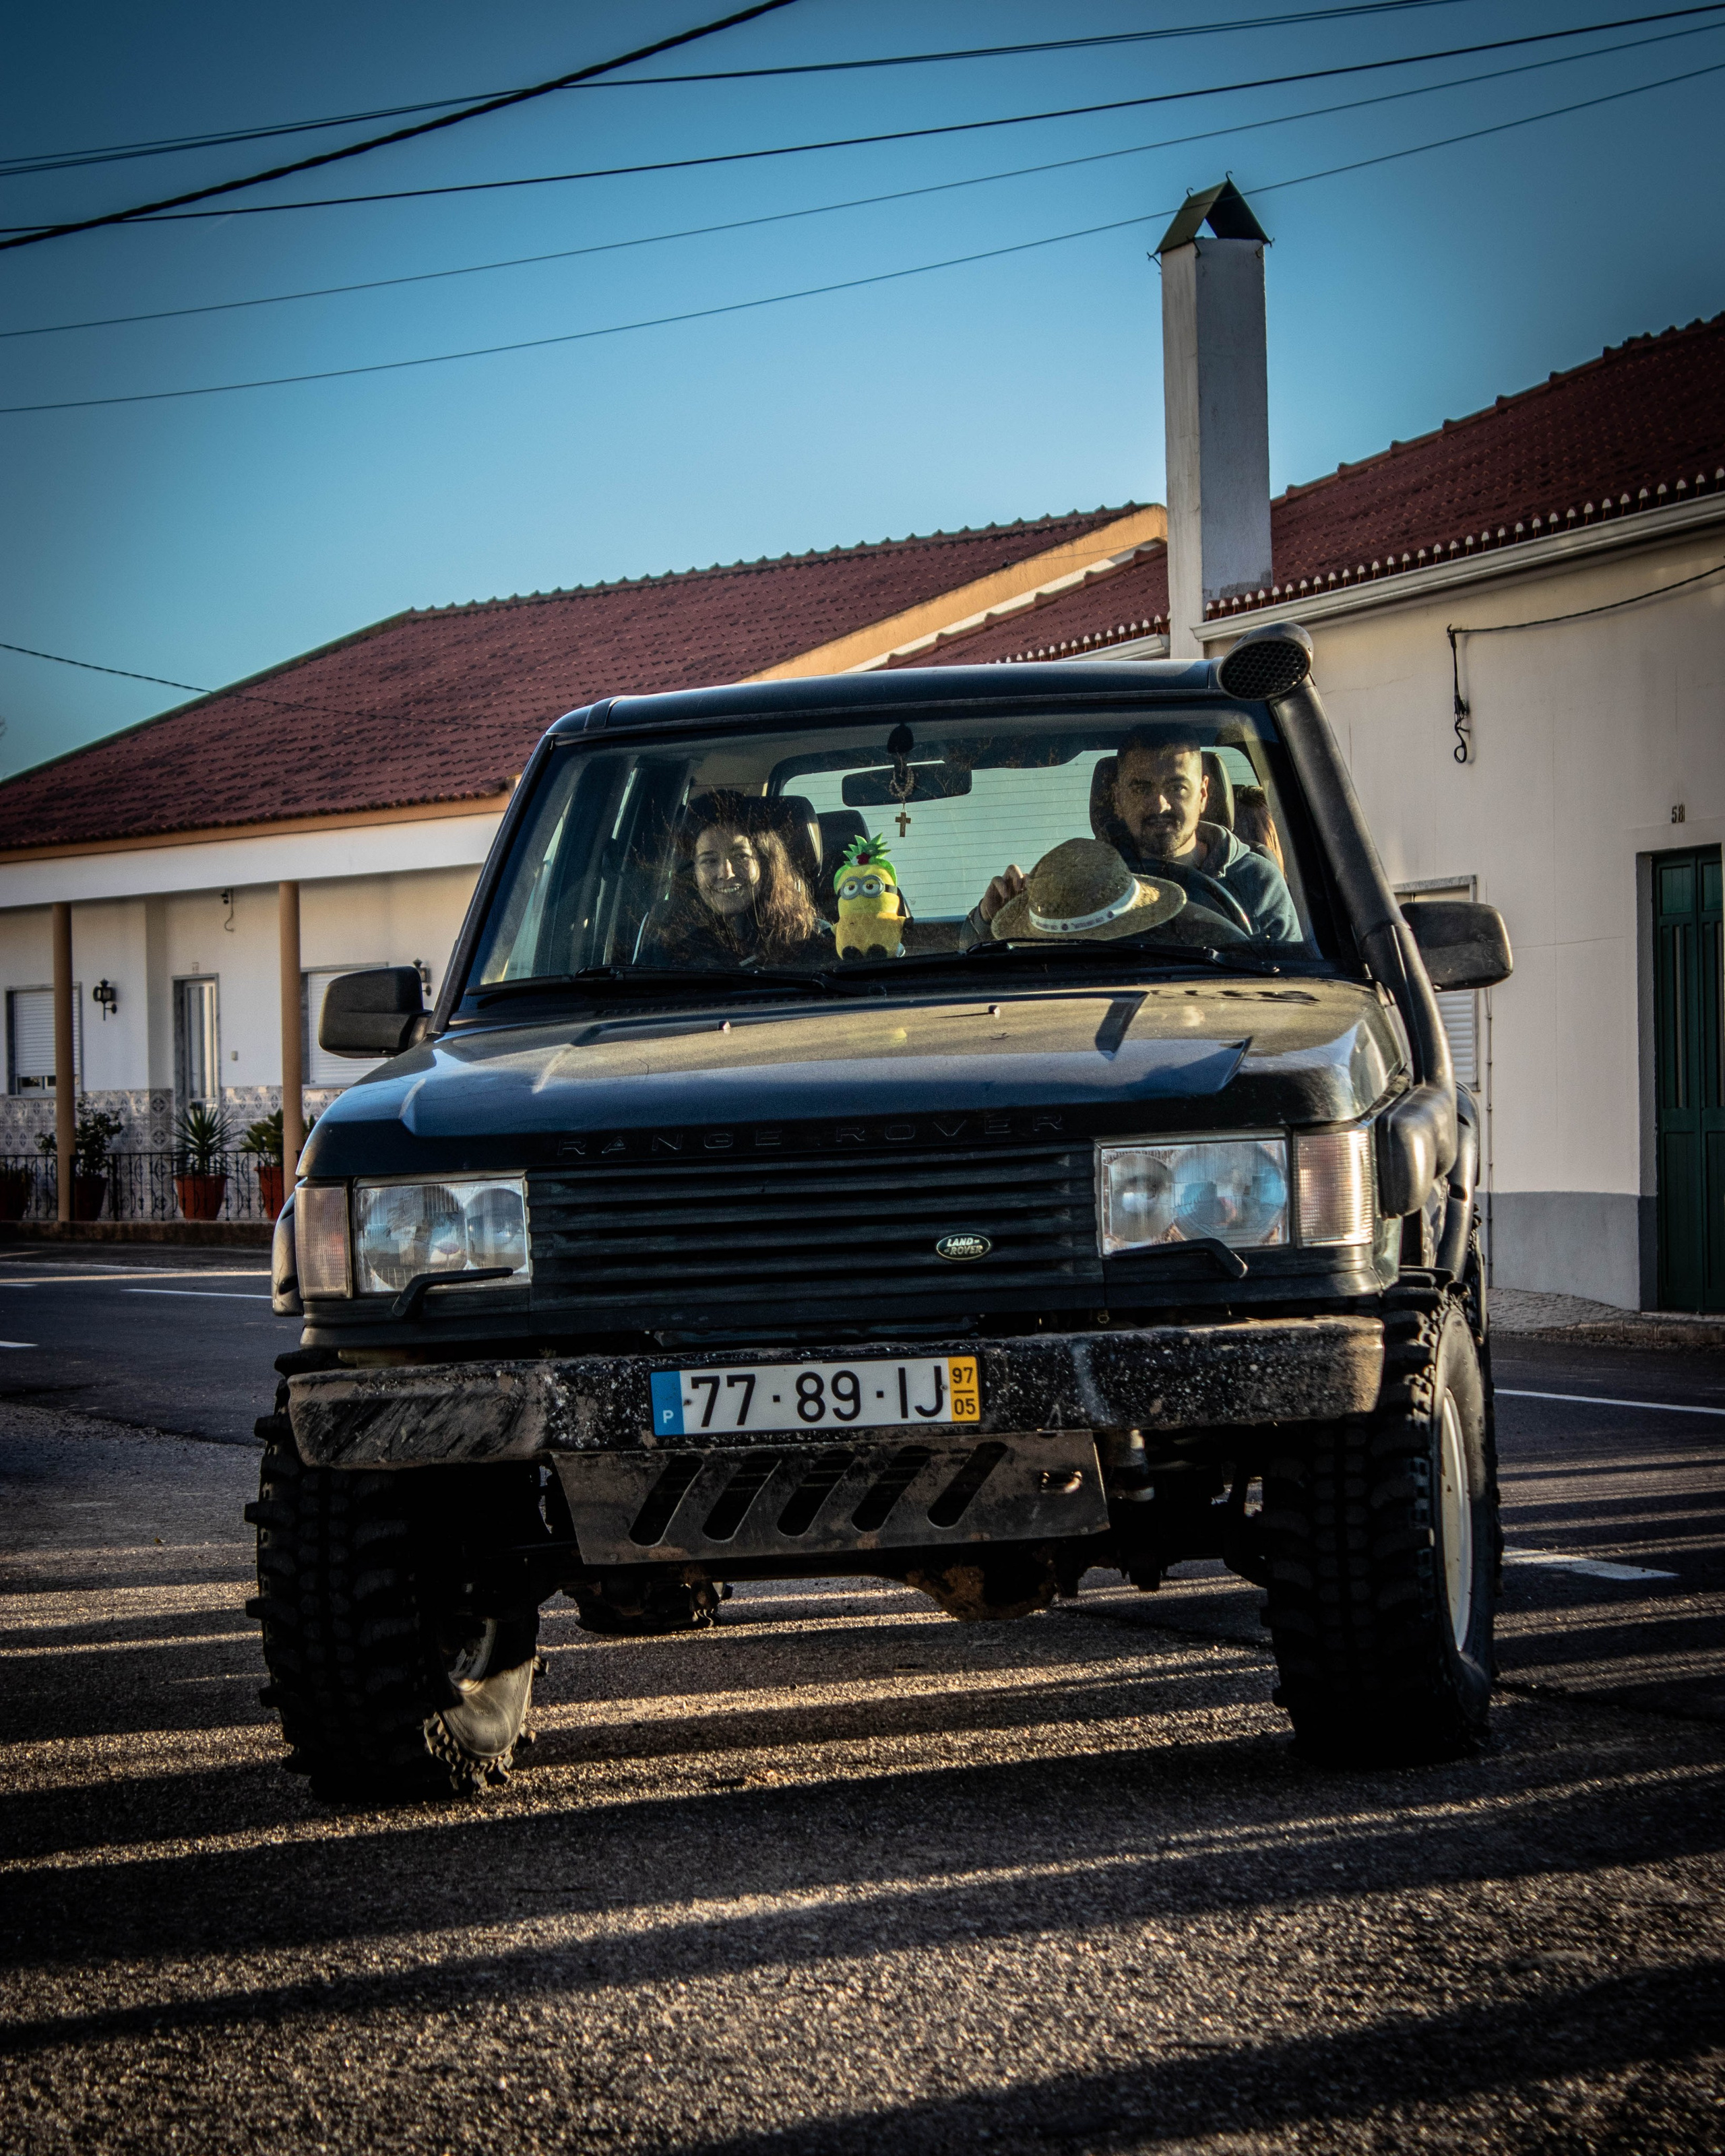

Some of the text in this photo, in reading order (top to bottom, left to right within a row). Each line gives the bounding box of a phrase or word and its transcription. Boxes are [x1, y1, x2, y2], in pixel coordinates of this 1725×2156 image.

[1671, 804, 1685, 823] 58
[557, 1113, 1064, 1156] RANGE ROVER
[947, 1237, 974, 1247] LAND
[949, 1245, 984, 1255] ROVER
[952, 1366, 973, 1384] 97
[954, 1398, 976, 1416] 05
[662, 1409, 675, 1424] P
